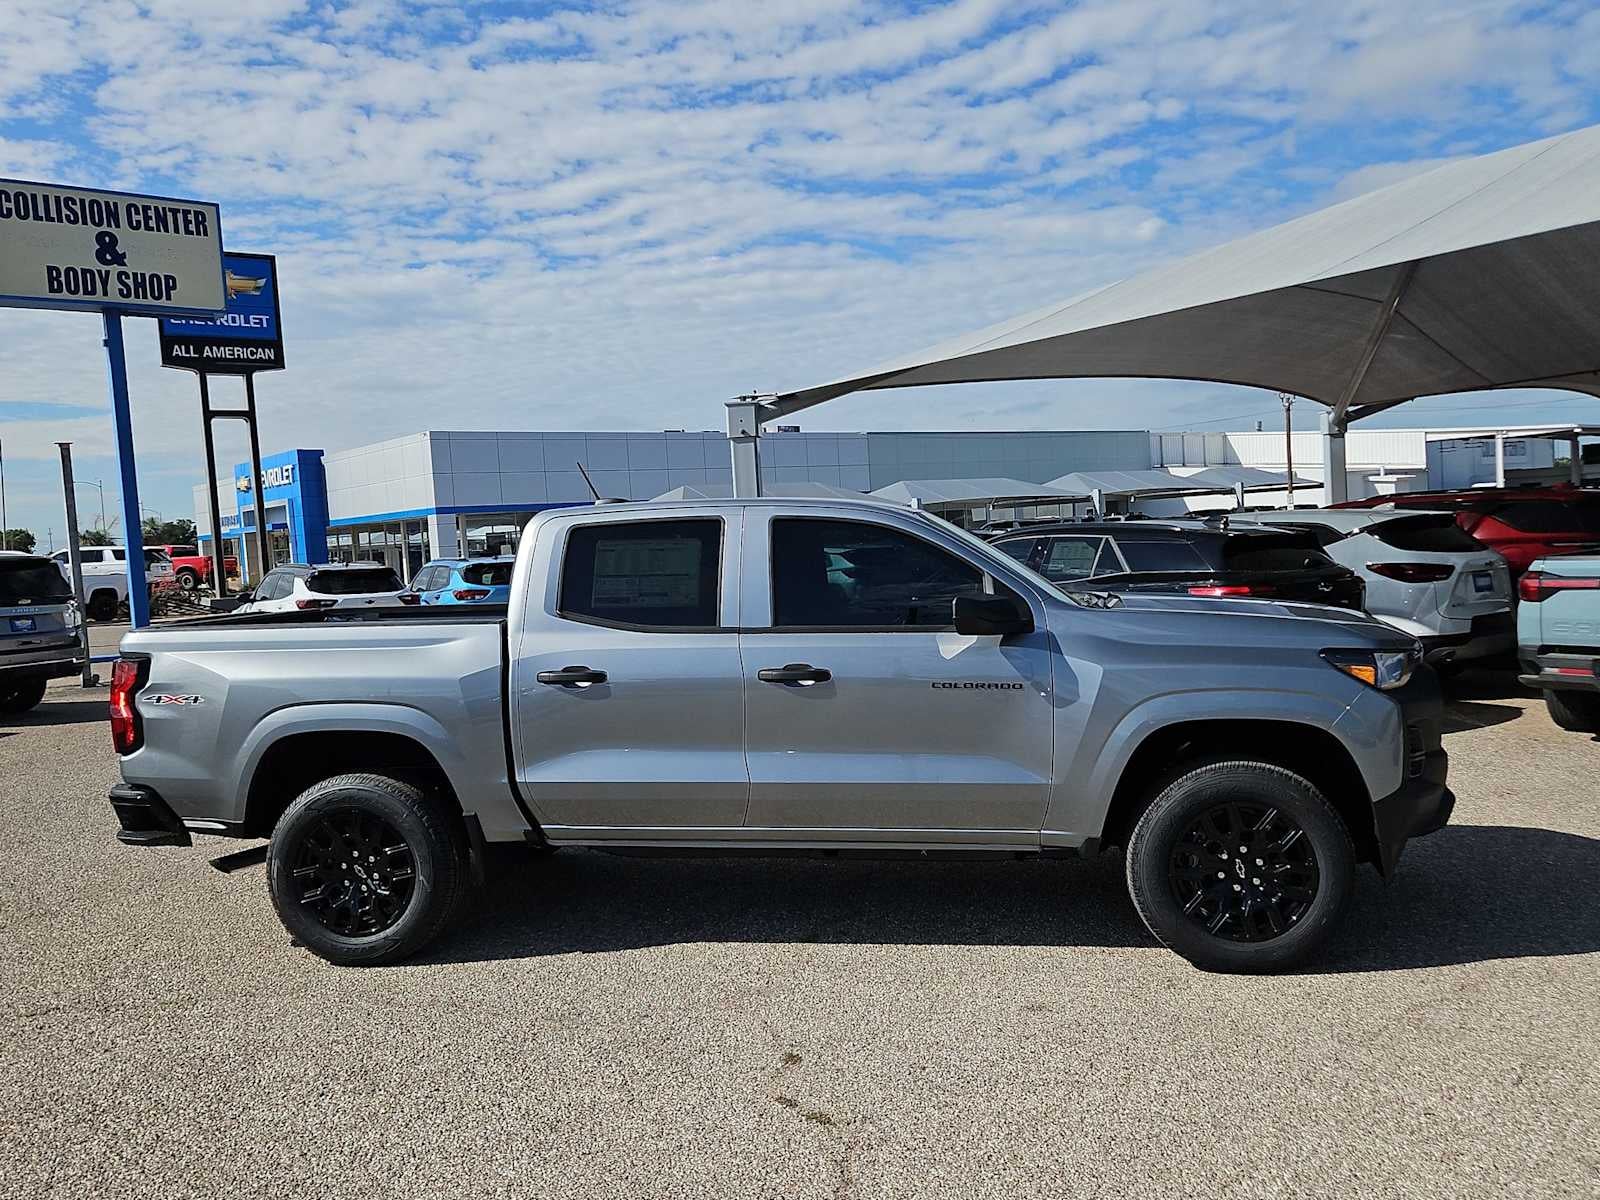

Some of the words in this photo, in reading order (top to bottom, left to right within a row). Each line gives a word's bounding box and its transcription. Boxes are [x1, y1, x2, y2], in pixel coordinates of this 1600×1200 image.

[0, 190, 120, 229] COLLISION
[126, 203, 208, 237] CENTER
[95, 231, 128, 267] &
[46, 265, 111, 297] BODY
[116, 270, 177, 301] SHOP
[172, 344, 199, 357] ALL
[203, 345, 275, 360] AMERICAN
[931, 682, 1023, 690] COLORADO
